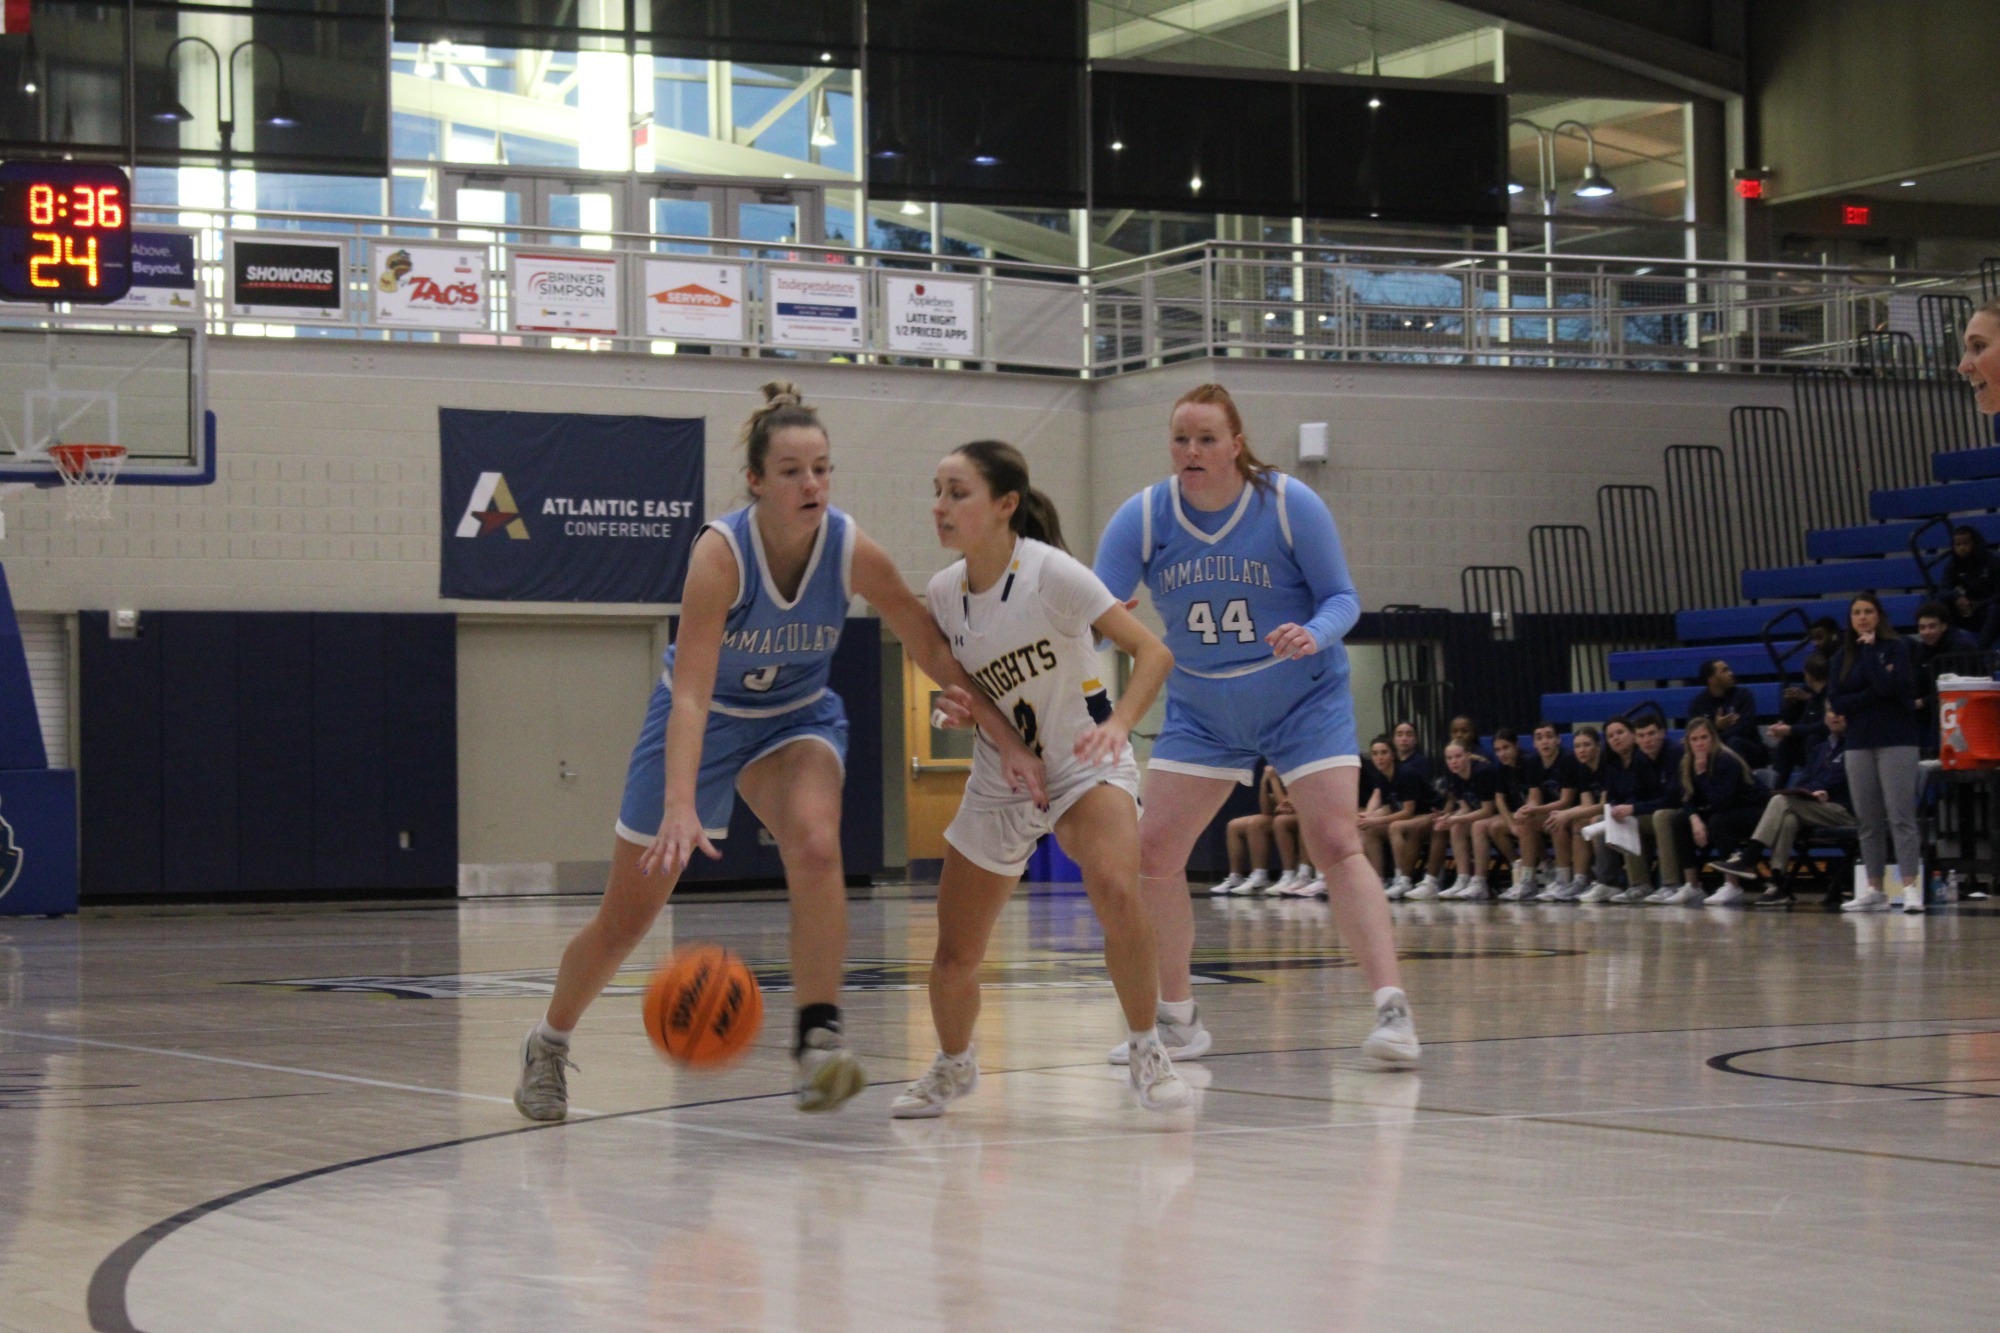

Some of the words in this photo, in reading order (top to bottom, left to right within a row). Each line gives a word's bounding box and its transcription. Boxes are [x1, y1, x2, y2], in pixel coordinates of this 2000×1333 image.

[29, 185, 122, 228] 8:36
[1845, 206, 1869, 224] EXIT
[30, 232, 98, 288] 24
[246, 265, 333, 284] SHOWORKS
[548, 272, 605, 285] BRINKER
[539, 283, 605, 298] SIMPSON
[777, 278, 855, 293] Independence
[666, 291, 721, 305] SERVPRO
[906, 312, 927, 324] LATE
[930, 314, 957, 326] NIGHT
[895, 325, 909, 336] 1/2
[911, 326, 942, 339] PRICED
[944, 329, 969, 341] APPS
[542, 497, 639, 517] ATLANTIC
[643, 500, 693, 518] EAST
[564, 521, 672, 538] CONFERENCE
[1158, 555, 1273, 595] IMMACULATA
[1186, 598, 1257, 645] 44
[969, 639, 1058, 700] NIGHTS
